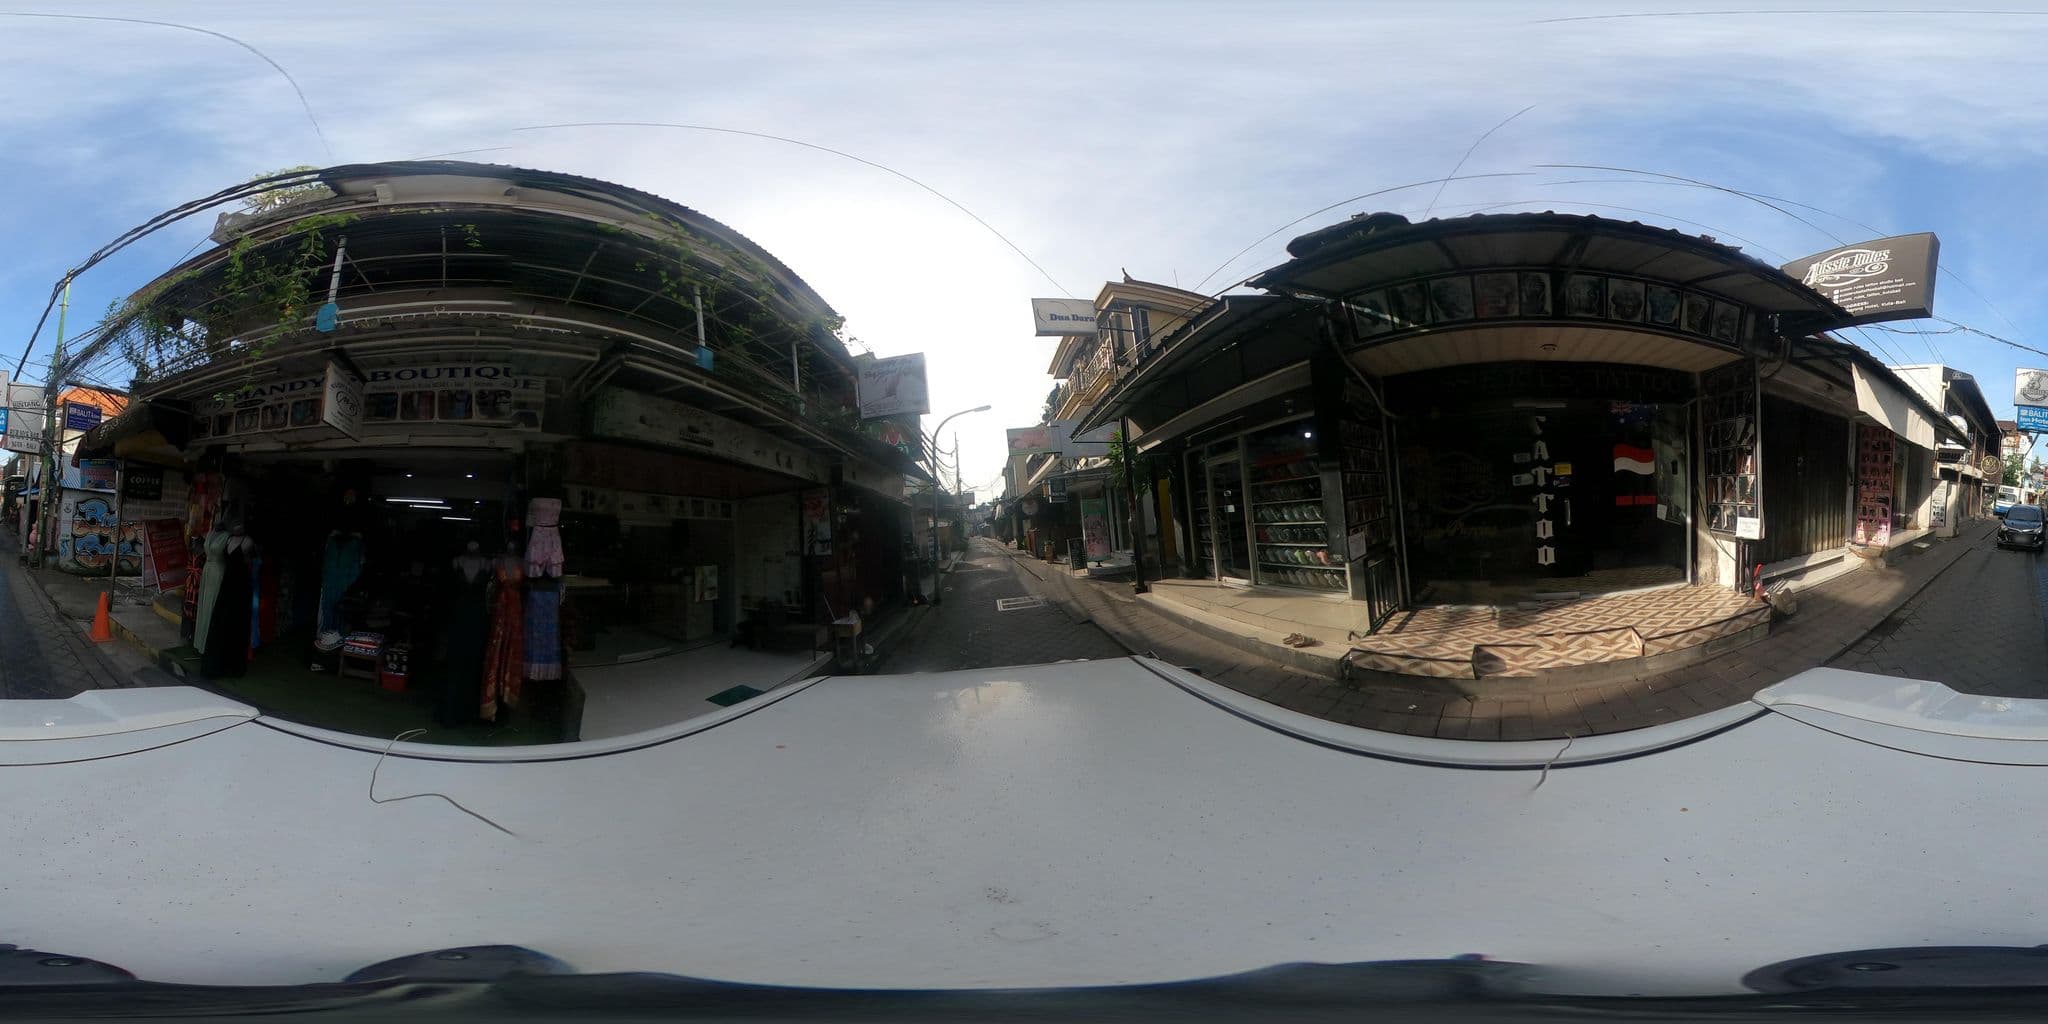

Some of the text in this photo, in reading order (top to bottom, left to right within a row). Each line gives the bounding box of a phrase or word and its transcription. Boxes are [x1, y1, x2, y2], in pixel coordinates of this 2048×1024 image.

[1802, 249, 1891, 286] Aussie Rules
[1050, 313, 1070, 321] Dua
